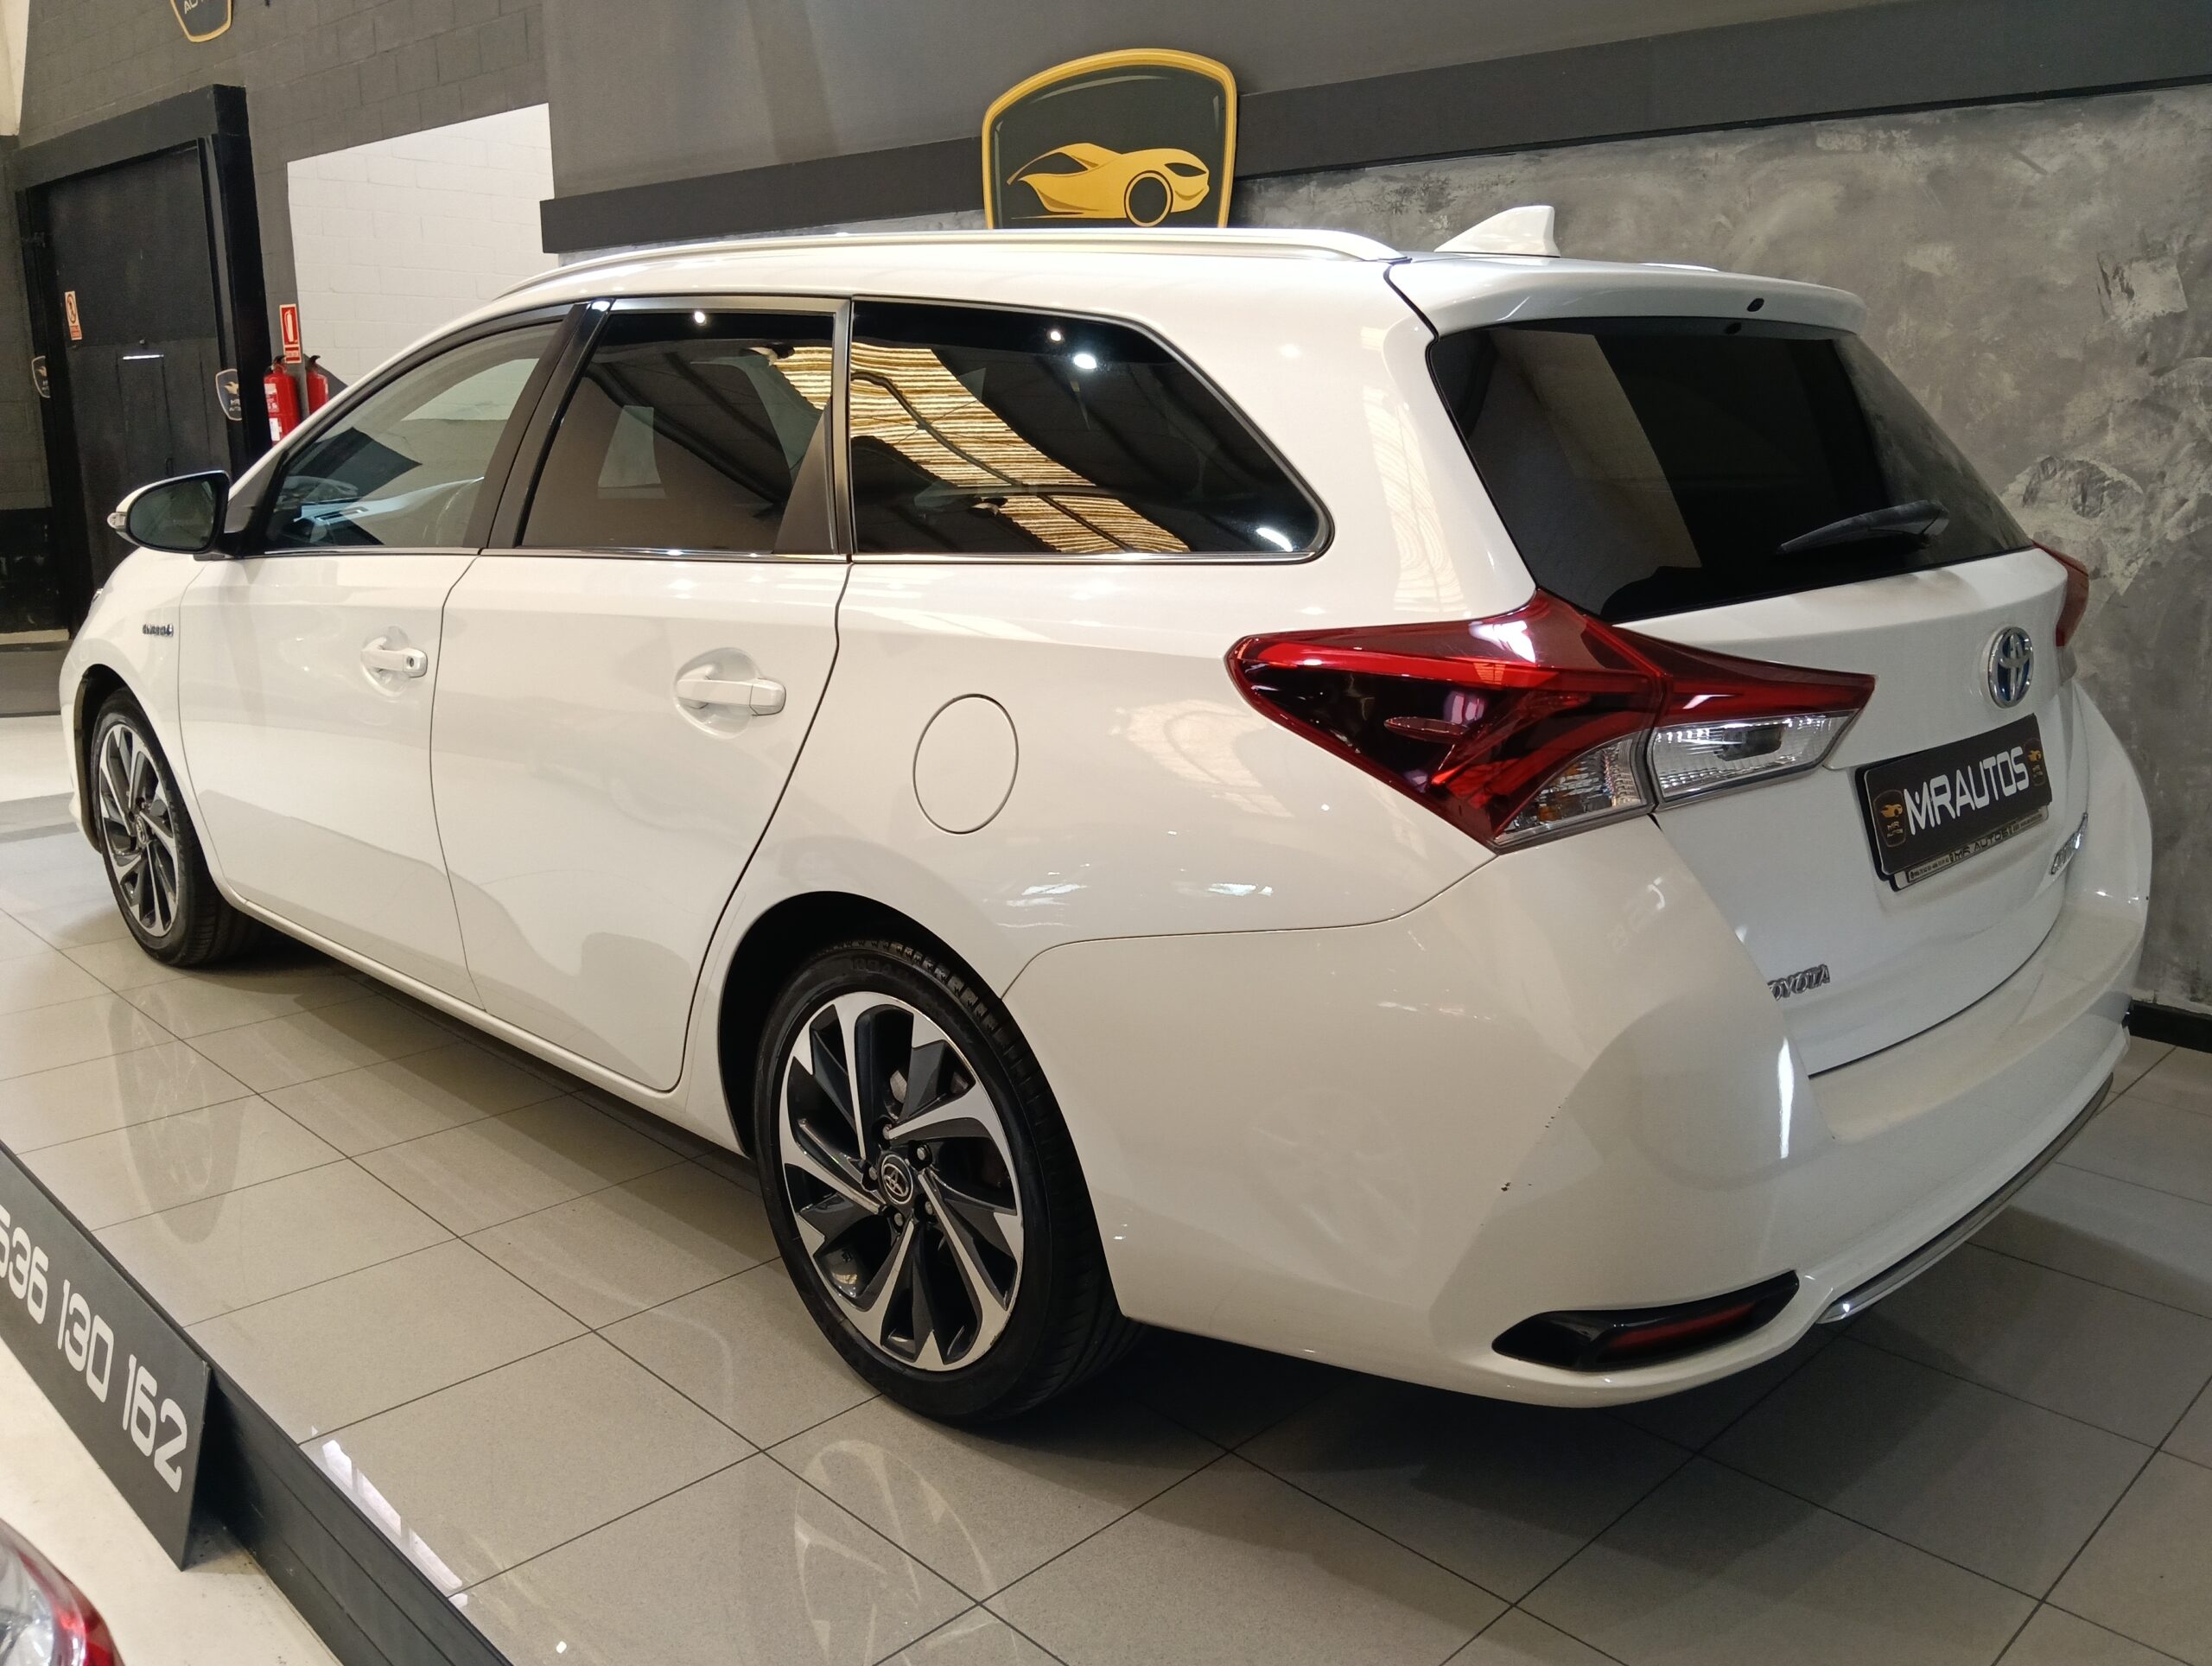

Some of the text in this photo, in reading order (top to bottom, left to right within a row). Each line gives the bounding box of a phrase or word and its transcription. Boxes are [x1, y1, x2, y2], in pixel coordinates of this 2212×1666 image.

[1767, 963, 1831, 1002] OYOTA
[58, 1279, 114, 1402] 130
[123, 1354, 188, 1492] 162
